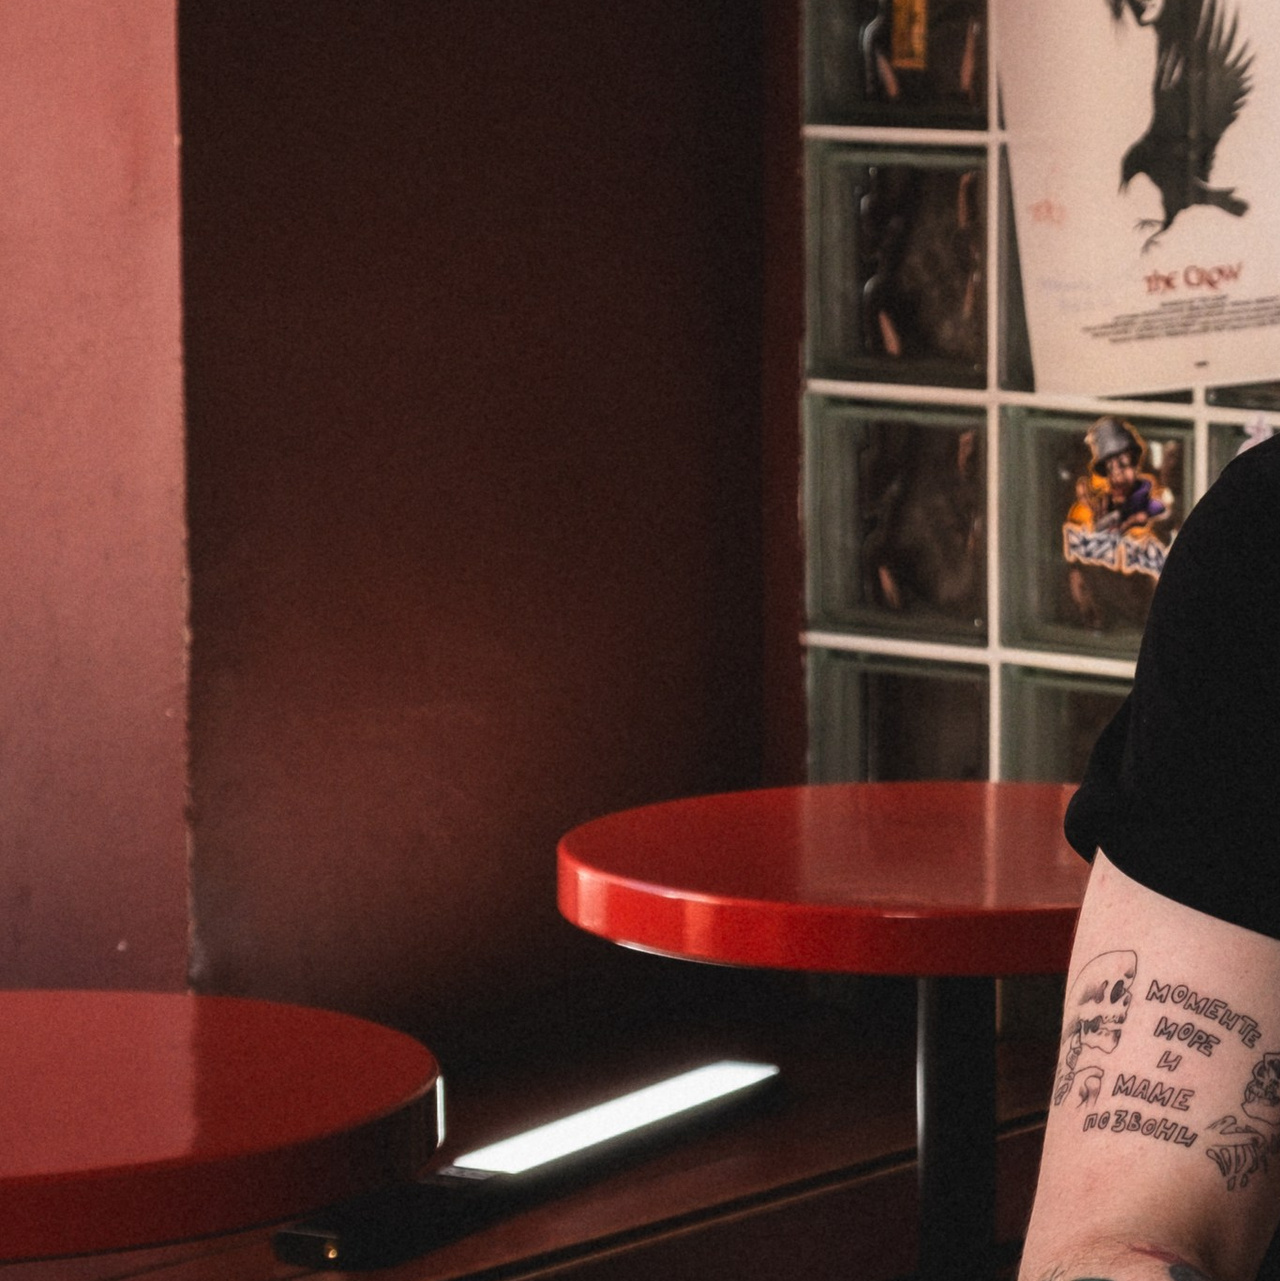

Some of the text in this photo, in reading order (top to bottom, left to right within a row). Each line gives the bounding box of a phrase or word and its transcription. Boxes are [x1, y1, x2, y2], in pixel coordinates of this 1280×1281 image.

[1146, 980, 1262, 1049] МОМЕНТЕ
[1153, 1016, 1221, 1058] МОРЕ
[1156, 1051, 1182, 1072] И
[1112, 1074, 1195, 1112] МАМЕ
